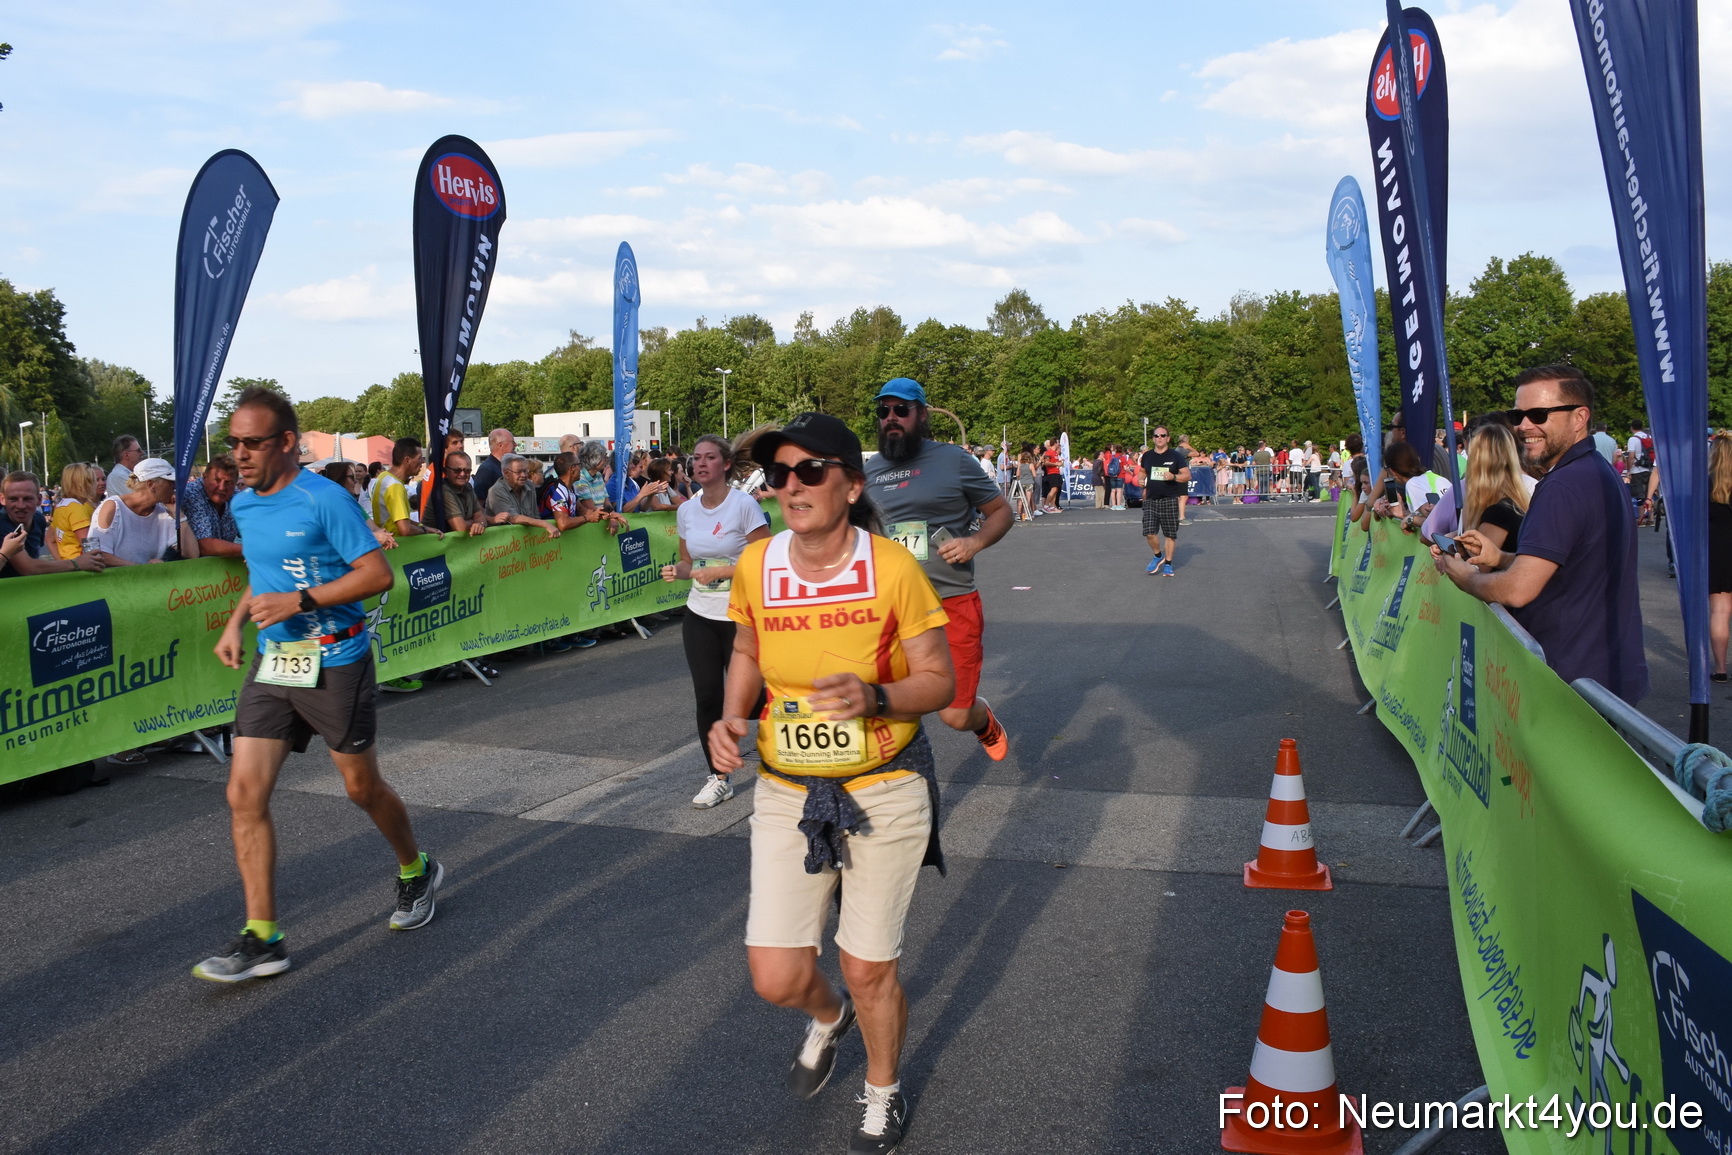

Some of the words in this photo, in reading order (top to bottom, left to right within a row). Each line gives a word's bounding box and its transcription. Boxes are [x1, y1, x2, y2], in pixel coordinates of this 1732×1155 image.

[437, 163, 495, 206] Hervis
[212, 184, 248, 264] Fischer
[226, 199, 253, 264] AUTOMOBILE
[875, 469, 910, 484] FINISHER
[168, 571, 244, 612] Gesunde
[416, 572, 445, 587] Fischer
[46, 614, 101, 648] Fischer
[386, 583, 485, 647] firmenlauf
[764, 615, 811, 632] MAX
[819, 608, 881, 629] BÖGL
[51, 636, 97, 654] AUTOMOBILE
[392, 631, 437, 657] neumarkt
[271, 655, 312, 675] 1733
[0, 639, 180, 735] firmenlauf
[6, 711, 90, 751] neumarkt
[781, 721, 851, 750] 1666
[1668, 988, 1732, 1088] Fisch
[1685, 1050, 1732, 1113] AUTOMO
